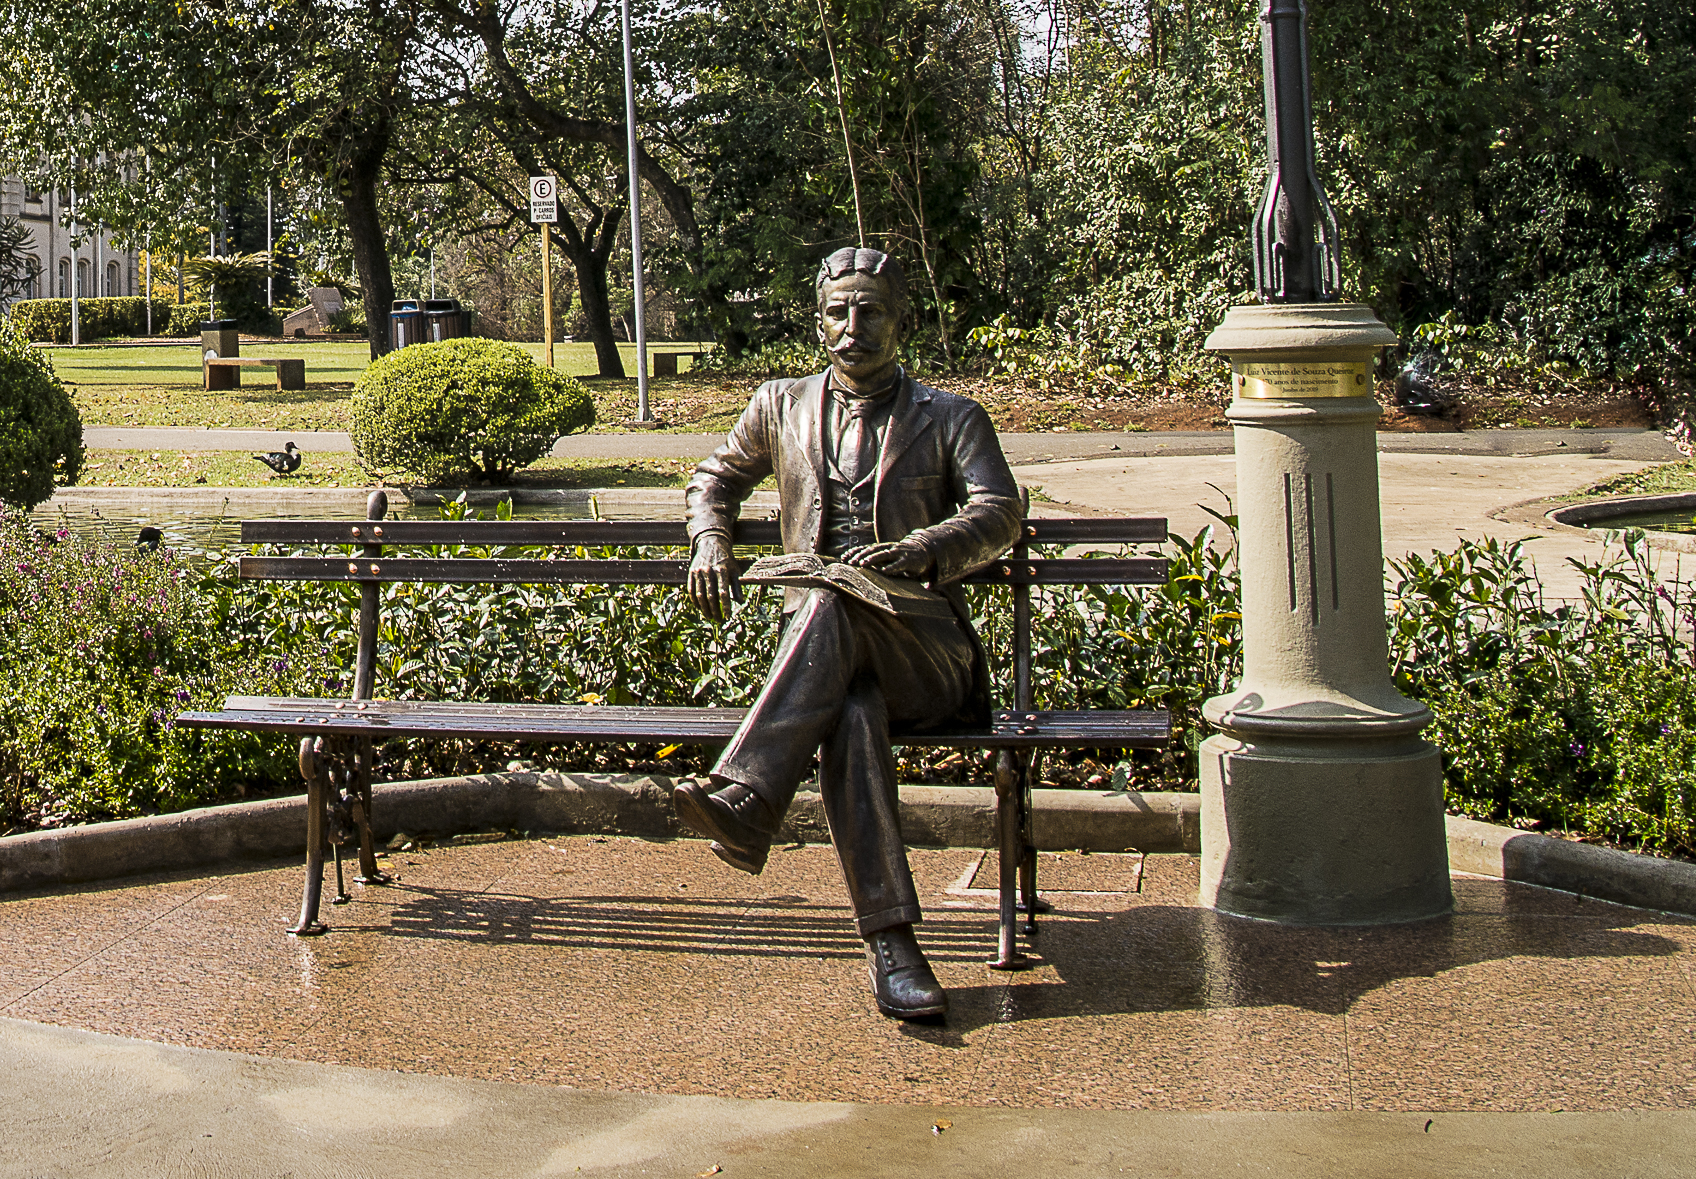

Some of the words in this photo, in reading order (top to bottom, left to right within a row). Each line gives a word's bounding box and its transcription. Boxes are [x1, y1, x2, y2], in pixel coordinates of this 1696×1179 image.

[540, 183, 546, 194] E
[1247, 368, 1260, 376] Luiz
[1261, 367, 1289, 376] Vicente
[1290, 367, 1301, 376] de
[1303, 367, 1326, 375] Souza
[1327, 367, 1354, 377] Queiroz
